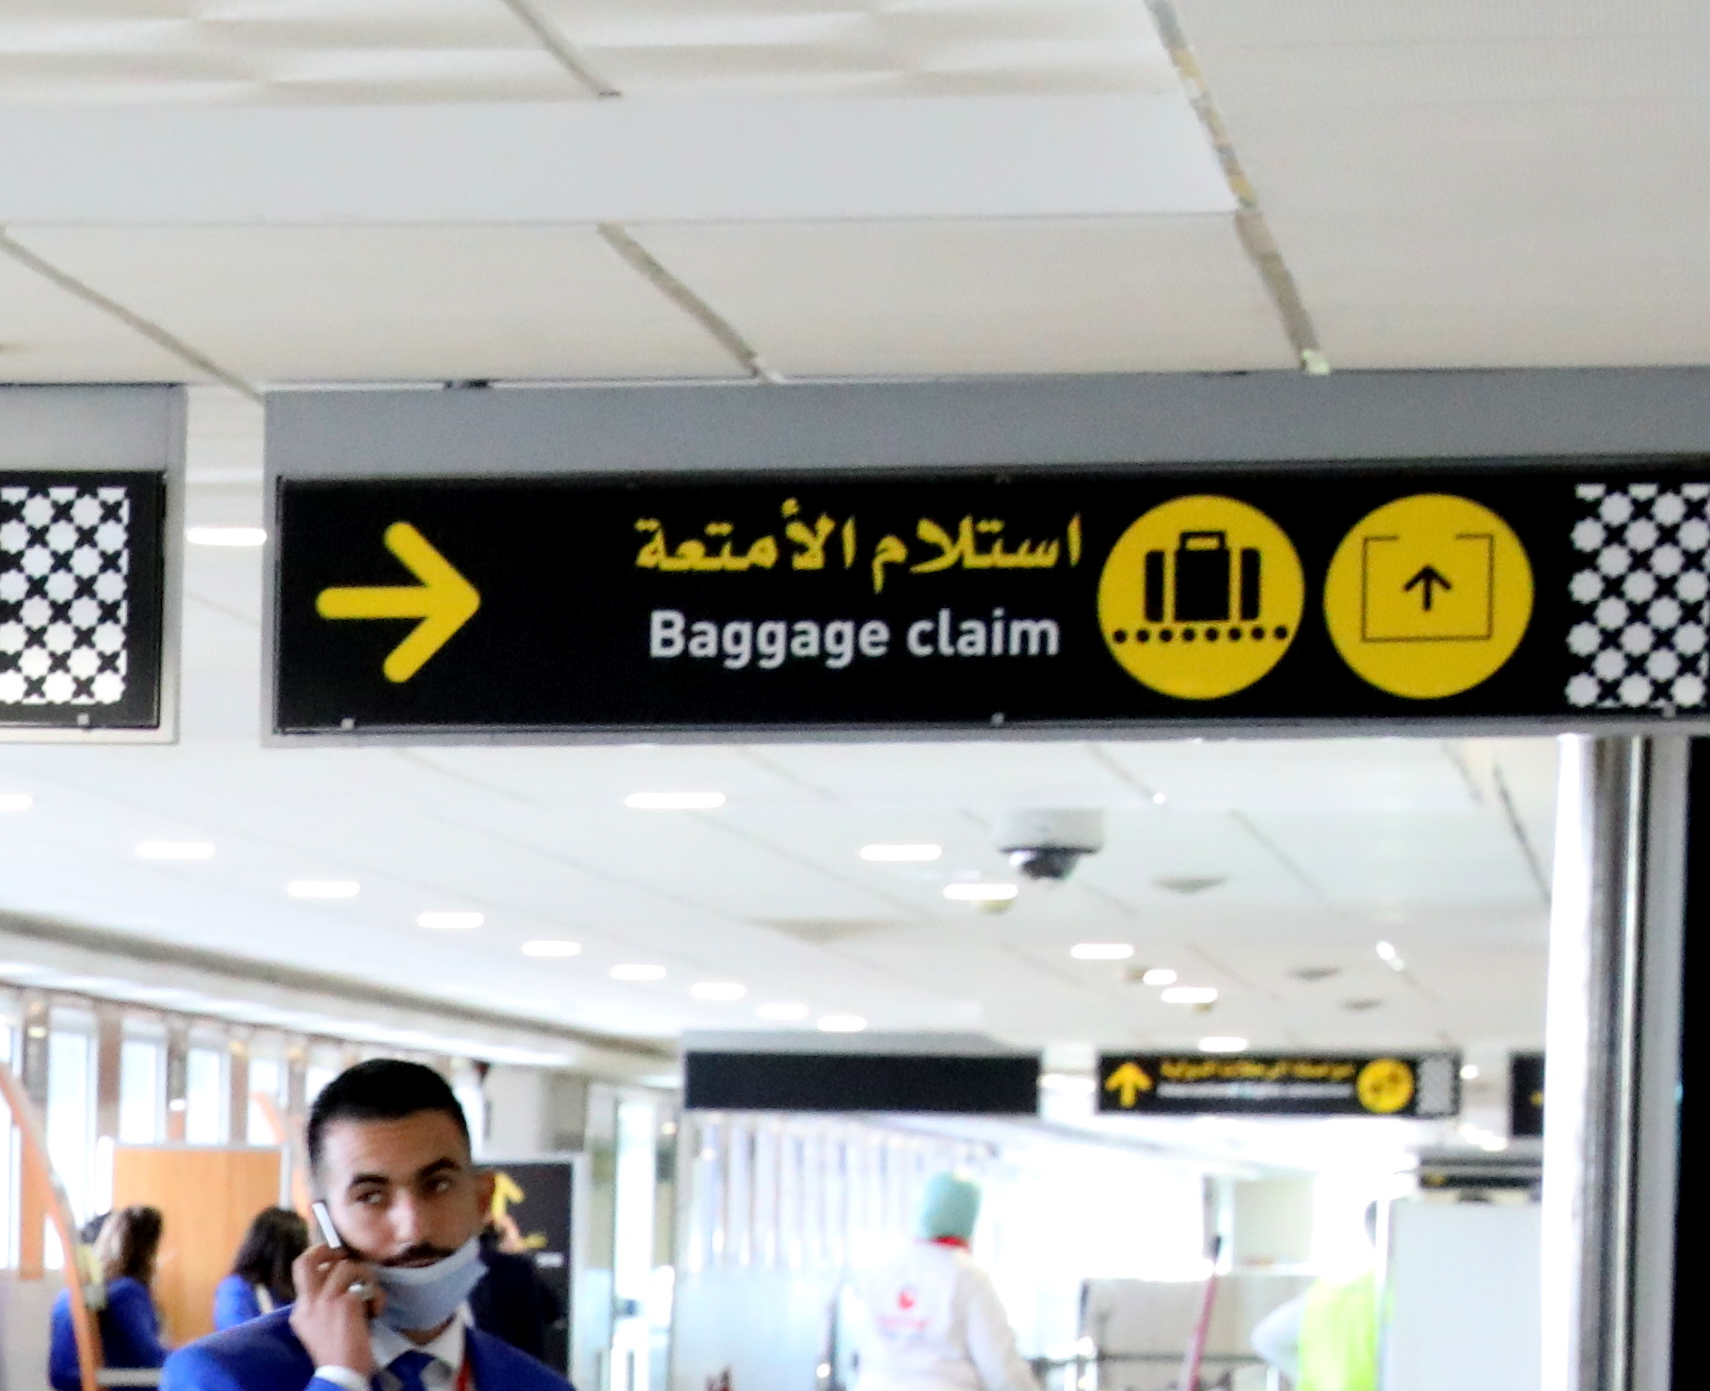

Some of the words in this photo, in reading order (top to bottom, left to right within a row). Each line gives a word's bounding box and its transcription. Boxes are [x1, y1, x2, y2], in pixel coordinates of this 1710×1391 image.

[636, 499, 855, 571] الأمتعة
[871, 514, 1082, 594] استلام
[650, 610, 889, 669] Baggage
[907, 609, 1059, 656] claim
